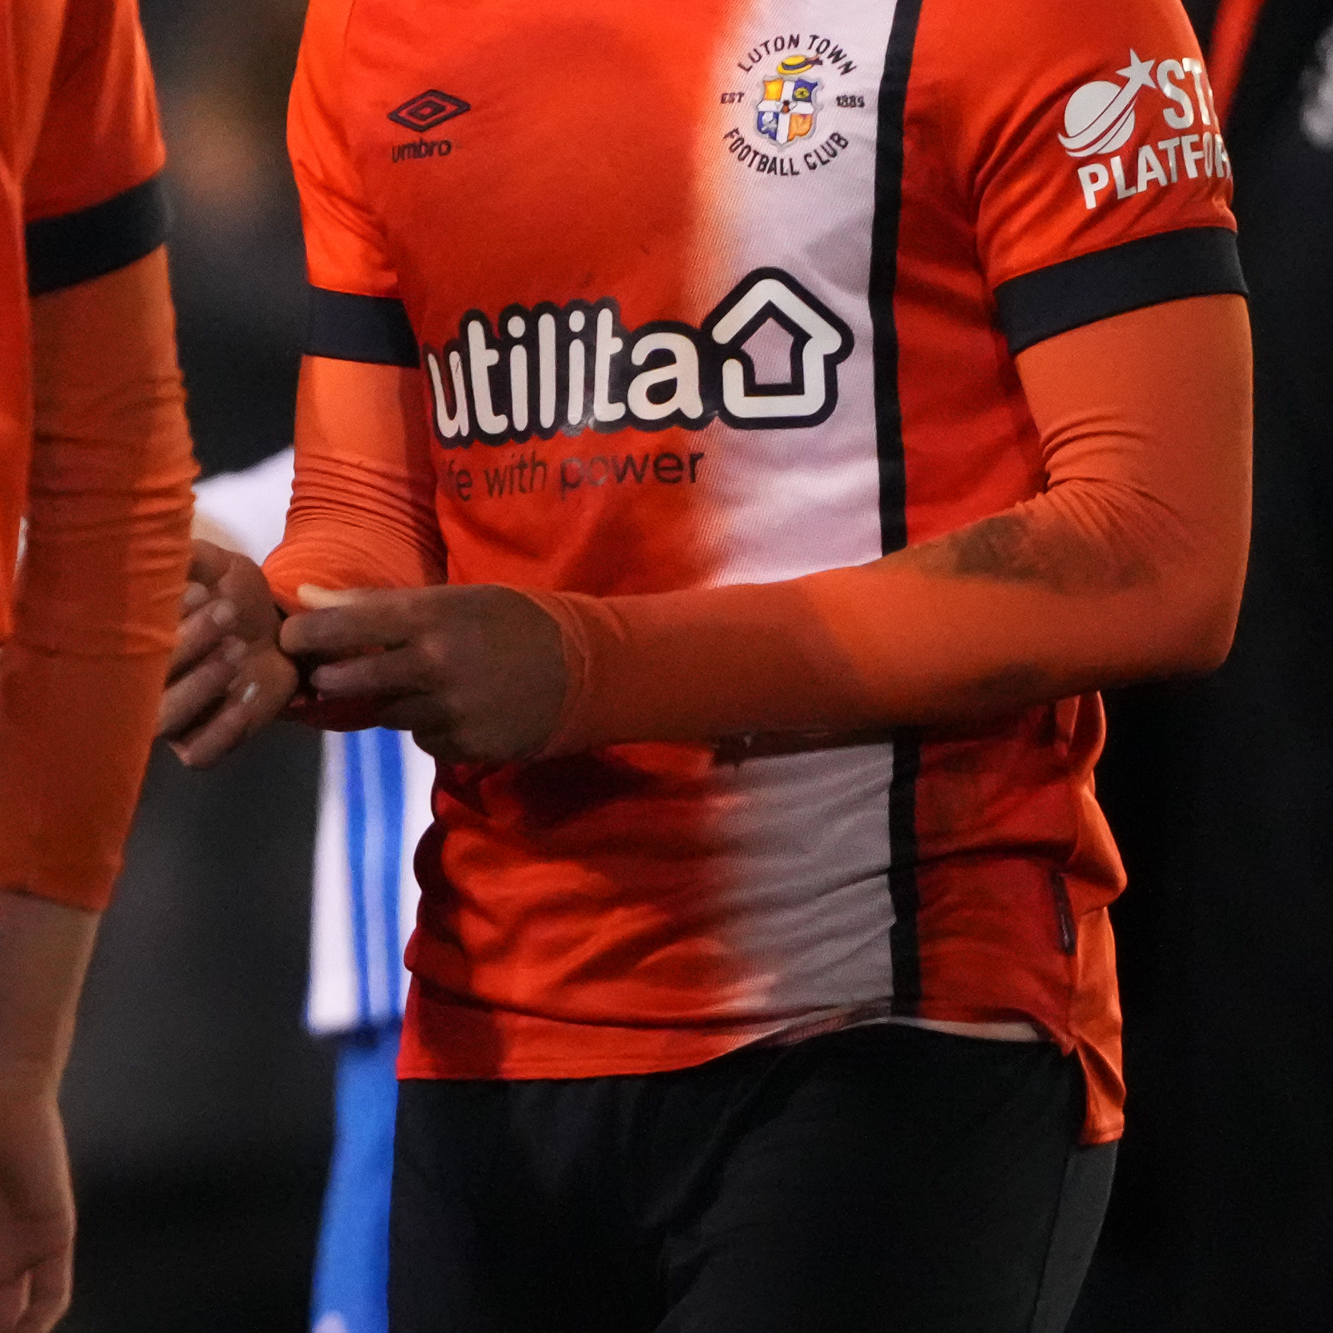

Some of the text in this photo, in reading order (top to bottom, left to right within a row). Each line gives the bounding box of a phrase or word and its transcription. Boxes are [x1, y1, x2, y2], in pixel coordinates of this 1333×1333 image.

[737, 33, 857, 76] LUTON TOWN
[720, 91, 745, 104] EST
[1156, 56, 1219, 130] ST
[391, 138, 453, 163] umbro
[723, 127, 849, 177] FOOTBALL CLUB
[1077, 130, 1232, 210] PLATFOR
[427, 307, 704, 439] utilita
[484, 449, 548, 499] with
[559, 451, 705, 501] power
